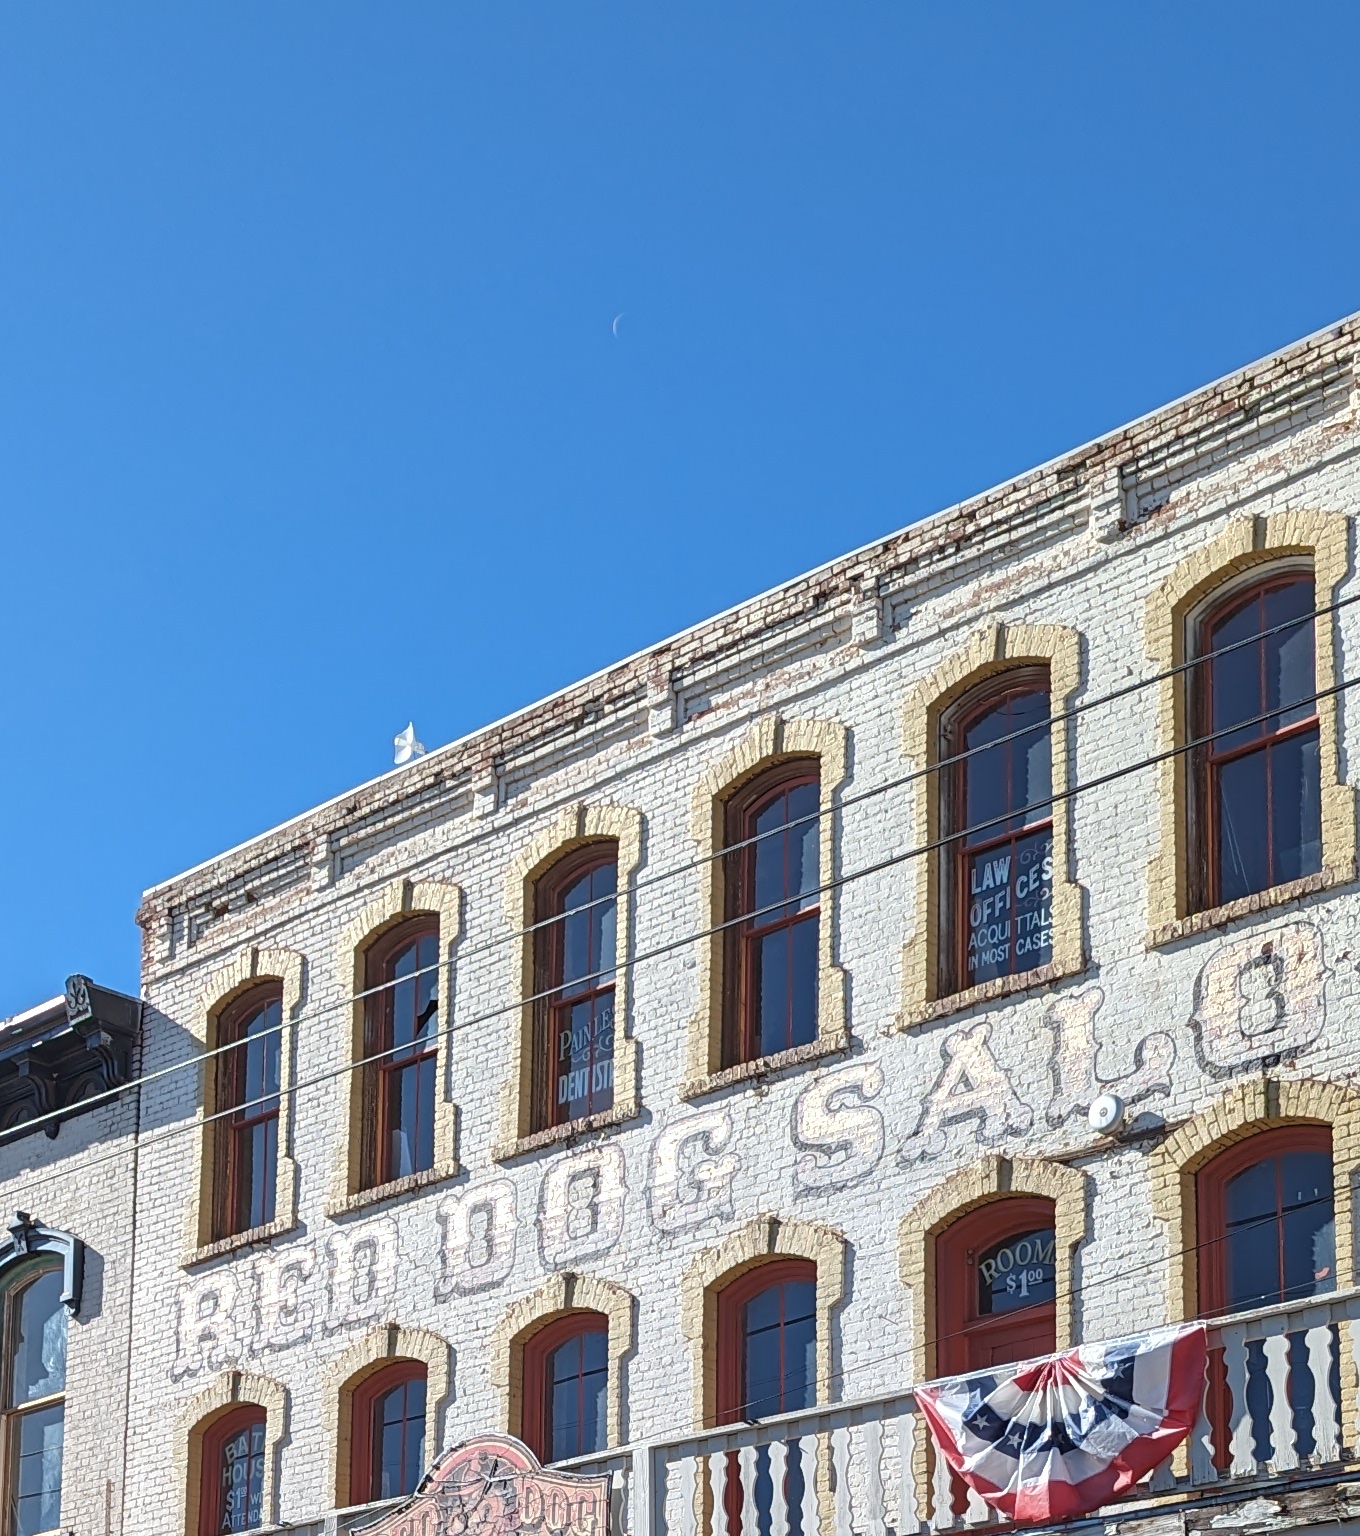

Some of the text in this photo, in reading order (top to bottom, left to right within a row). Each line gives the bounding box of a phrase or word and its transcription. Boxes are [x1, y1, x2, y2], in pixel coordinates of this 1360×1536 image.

[970, 856, 1053, 927] OFFICES
[971, 855, 1011, 895] LAW
[968, 928, 1053, 971] IN MOST CASES
[171, 1216, 399, 1381] RED
[434, 1109, 741, 1304] DOG
[225, 1432, 265, 1464] BAT
[222, 1458, 264, 1487] HOUS
